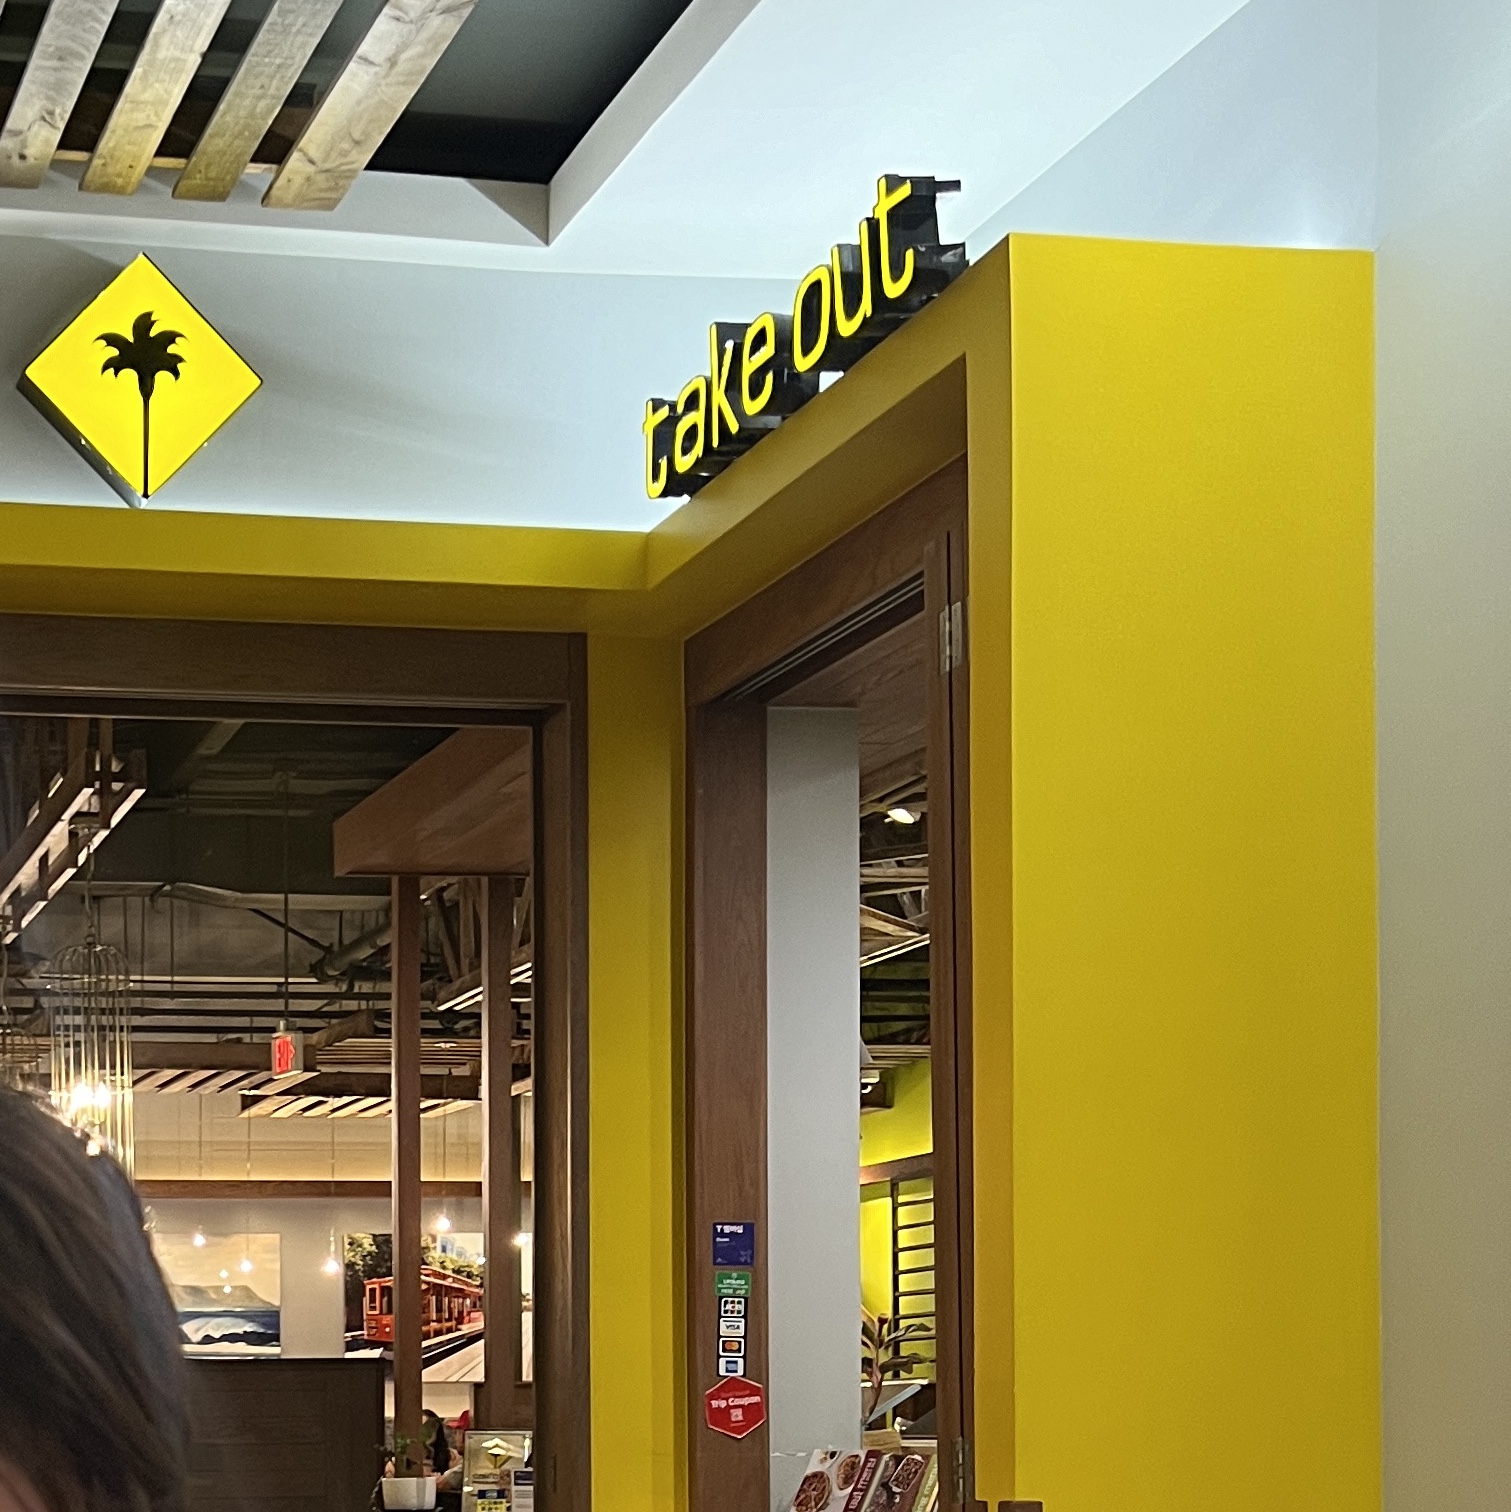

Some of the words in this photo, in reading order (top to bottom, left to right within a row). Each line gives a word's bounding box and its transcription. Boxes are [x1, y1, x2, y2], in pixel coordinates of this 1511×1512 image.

[643, 312, 776, 499] take
[793, 175, 914, 373] out
[710, 1398, 727, 1409] Trip
[728, 1395, 761, 1406] Coupon
